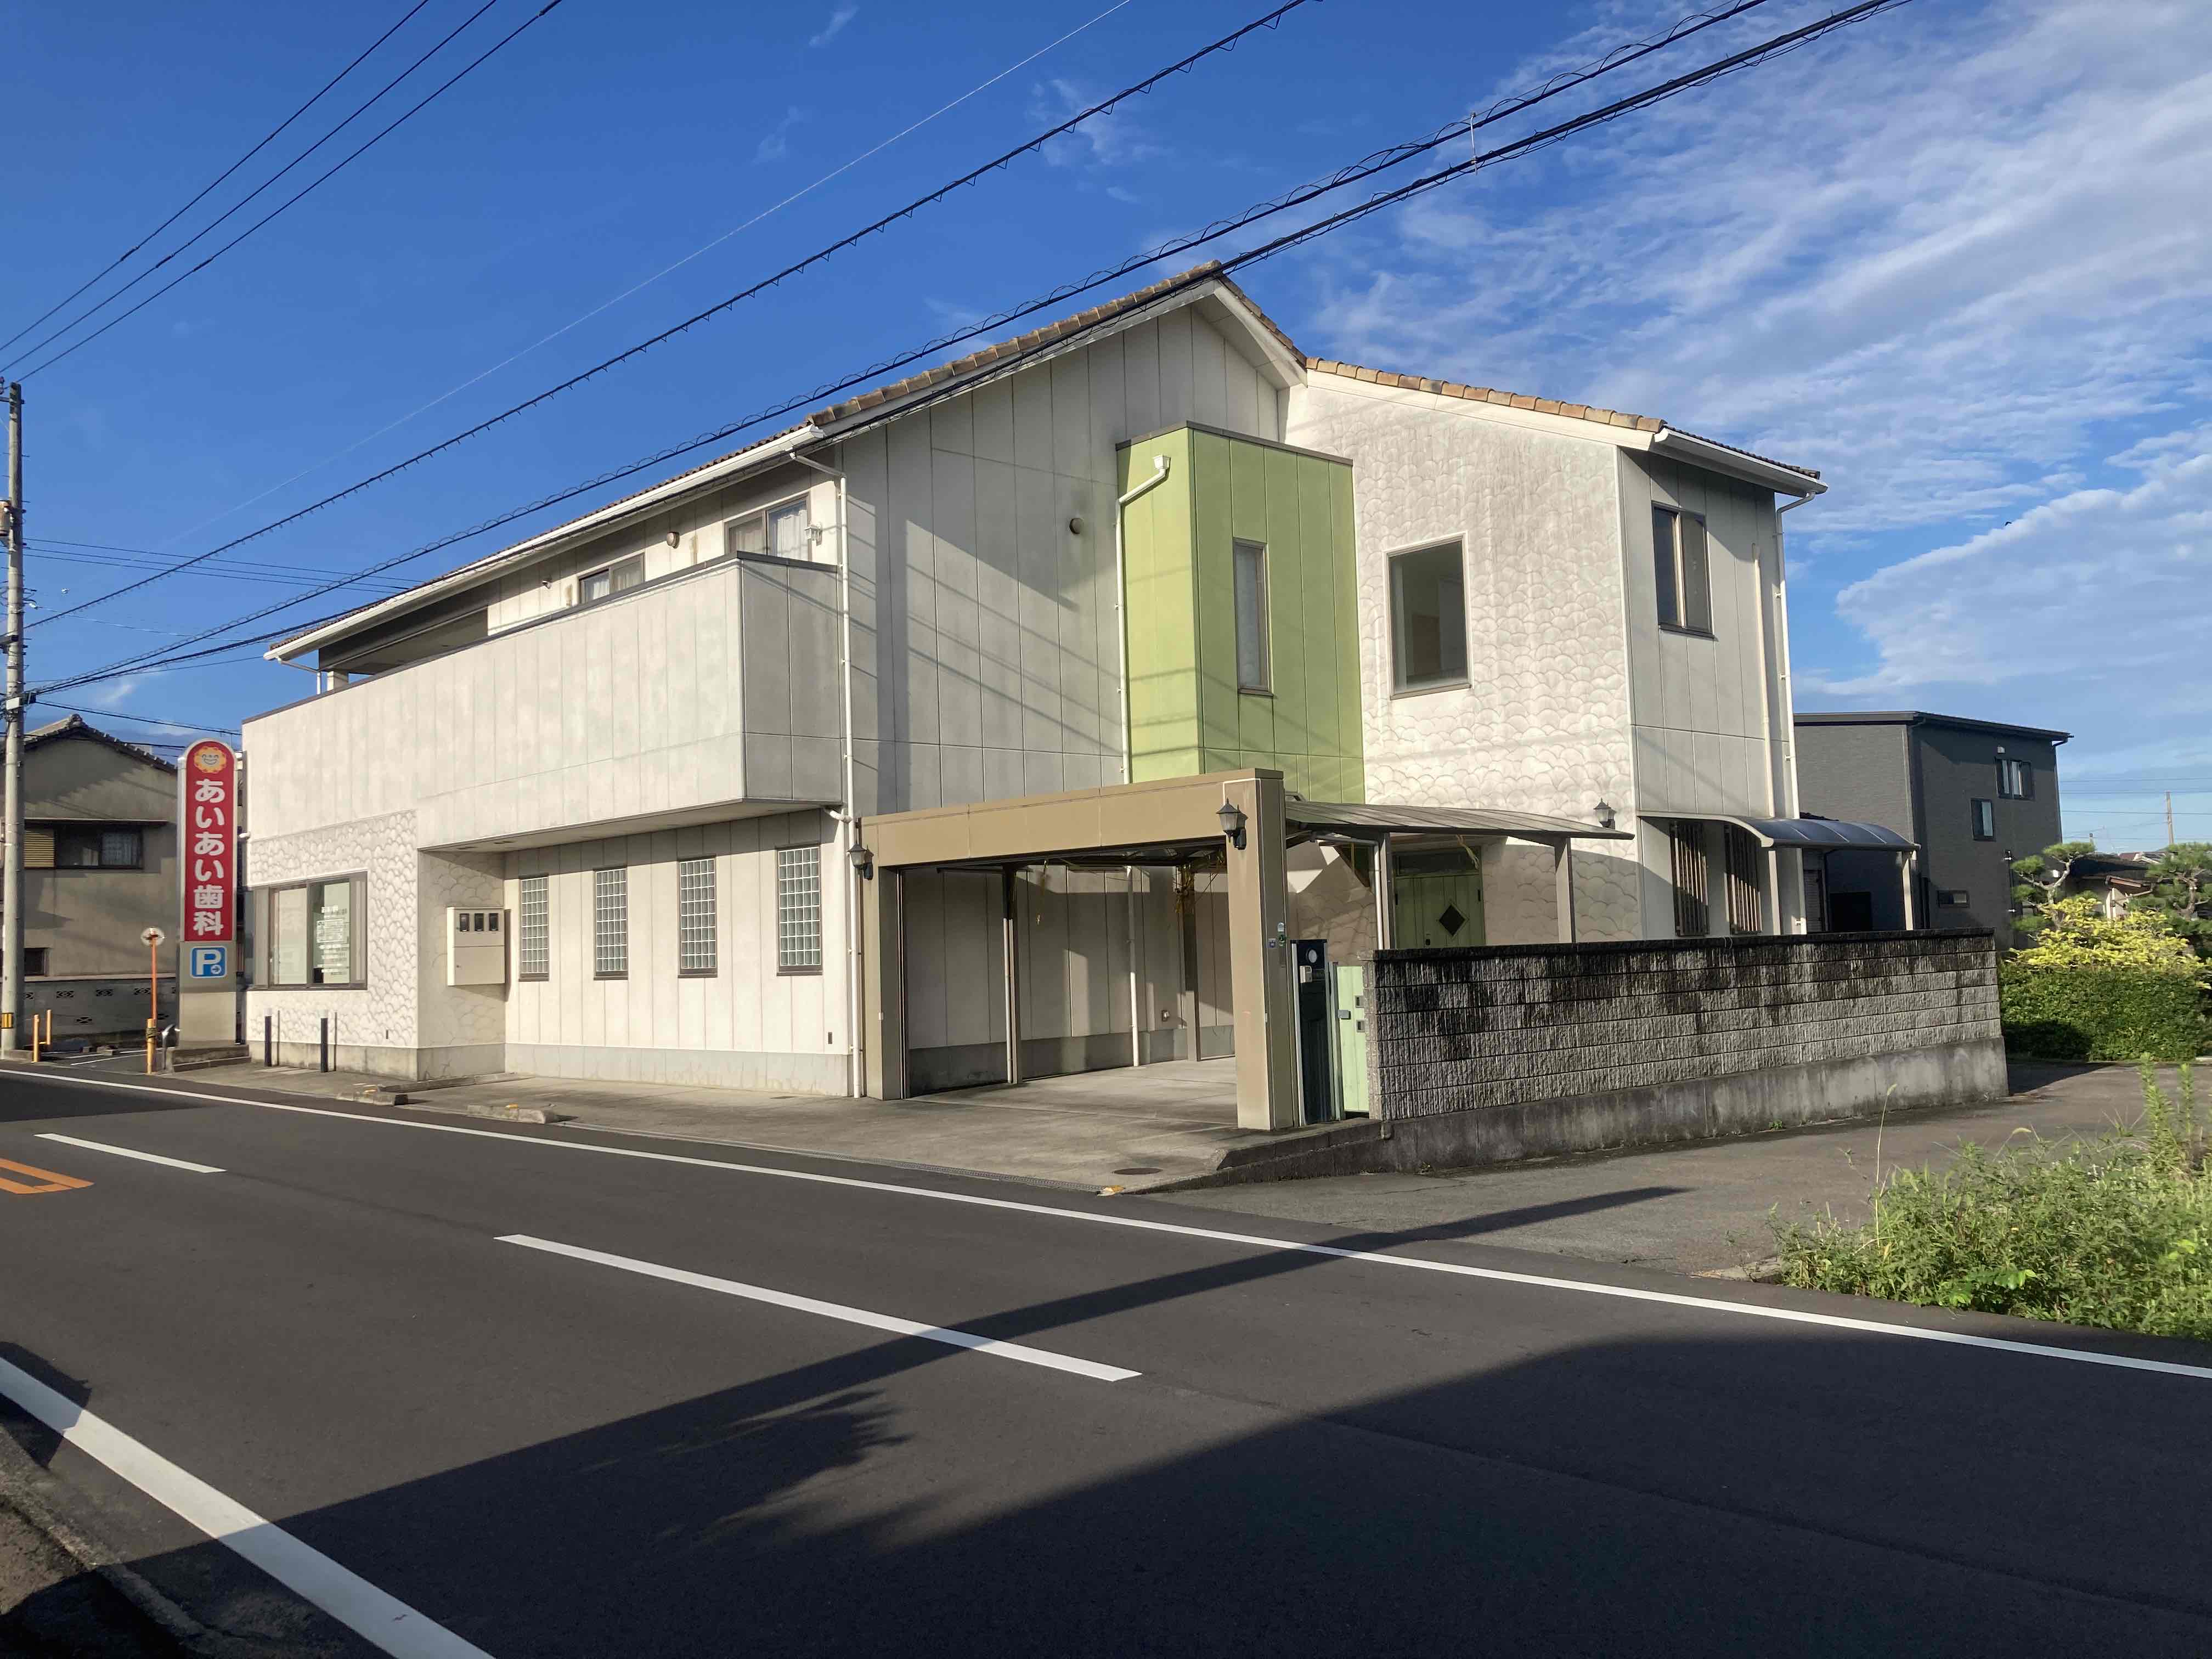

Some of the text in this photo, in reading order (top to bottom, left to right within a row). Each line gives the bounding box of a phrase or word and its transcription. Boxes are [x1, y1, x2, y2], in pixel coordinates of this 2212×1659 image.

[194, 778, 225, 935] あいあい歯科
[196, 949, 222, 975] P
